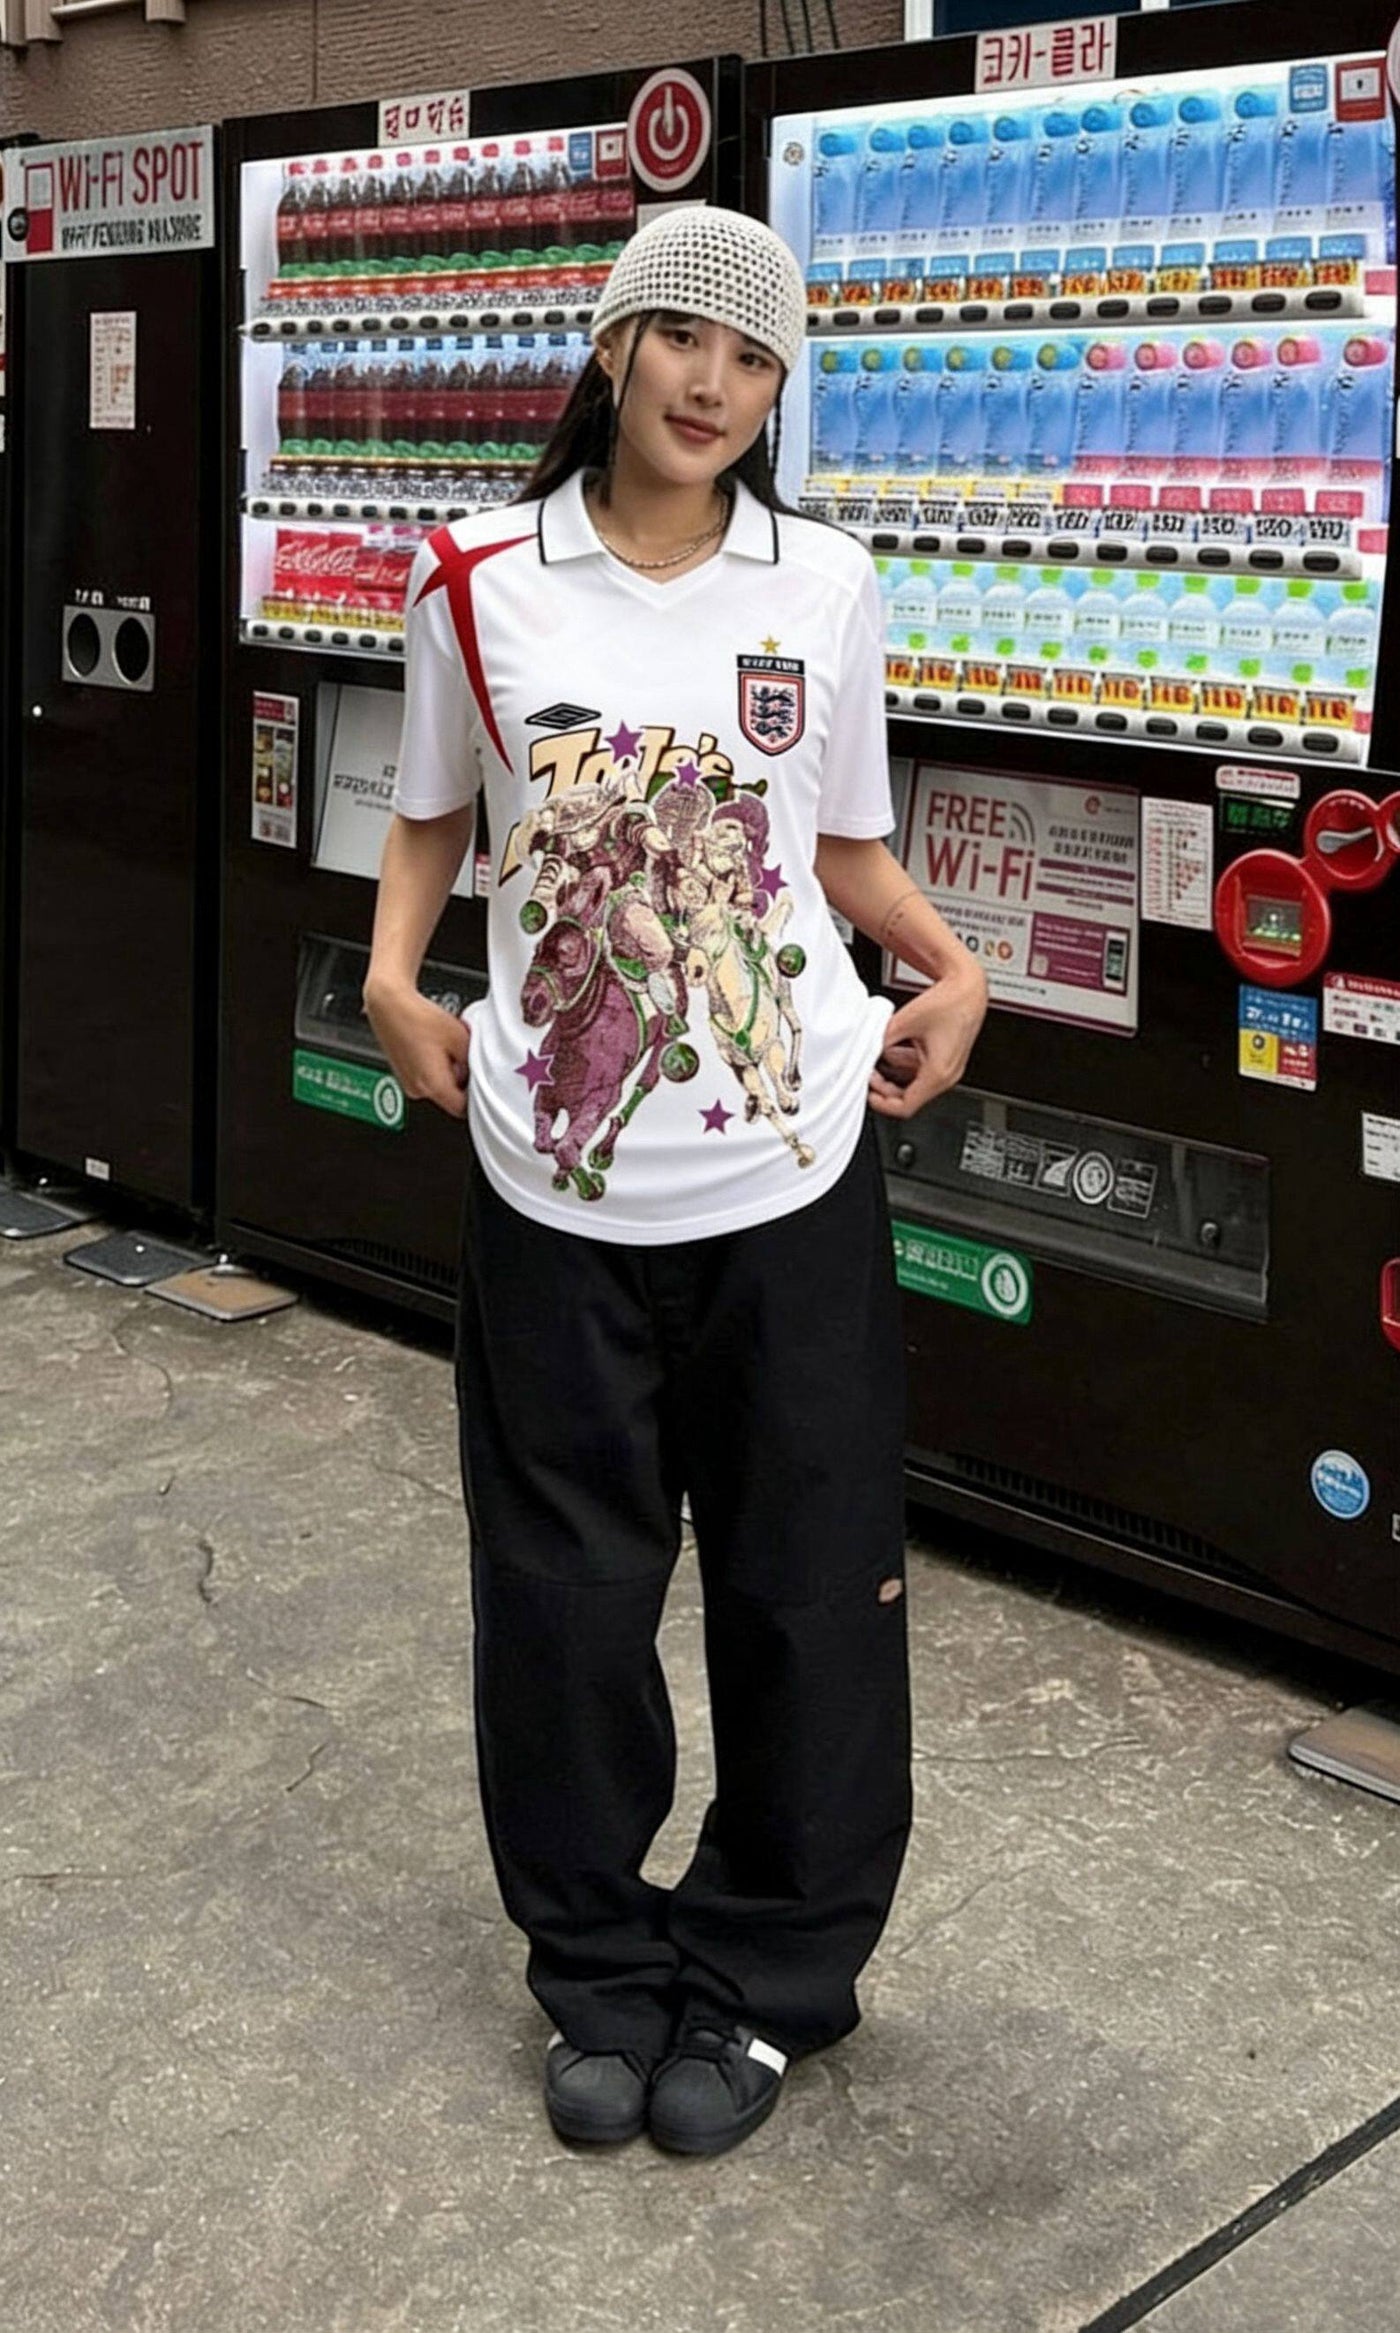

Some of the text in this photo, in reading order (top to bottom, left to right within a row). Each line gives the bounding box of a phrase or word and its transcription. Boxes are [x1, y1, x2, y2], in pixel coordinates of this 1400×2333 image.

[132, 142, 204, 205] SPOT
[926, 790, 1007, 839] FREE
[925, 833, 1036, 901] Wi-Fi
